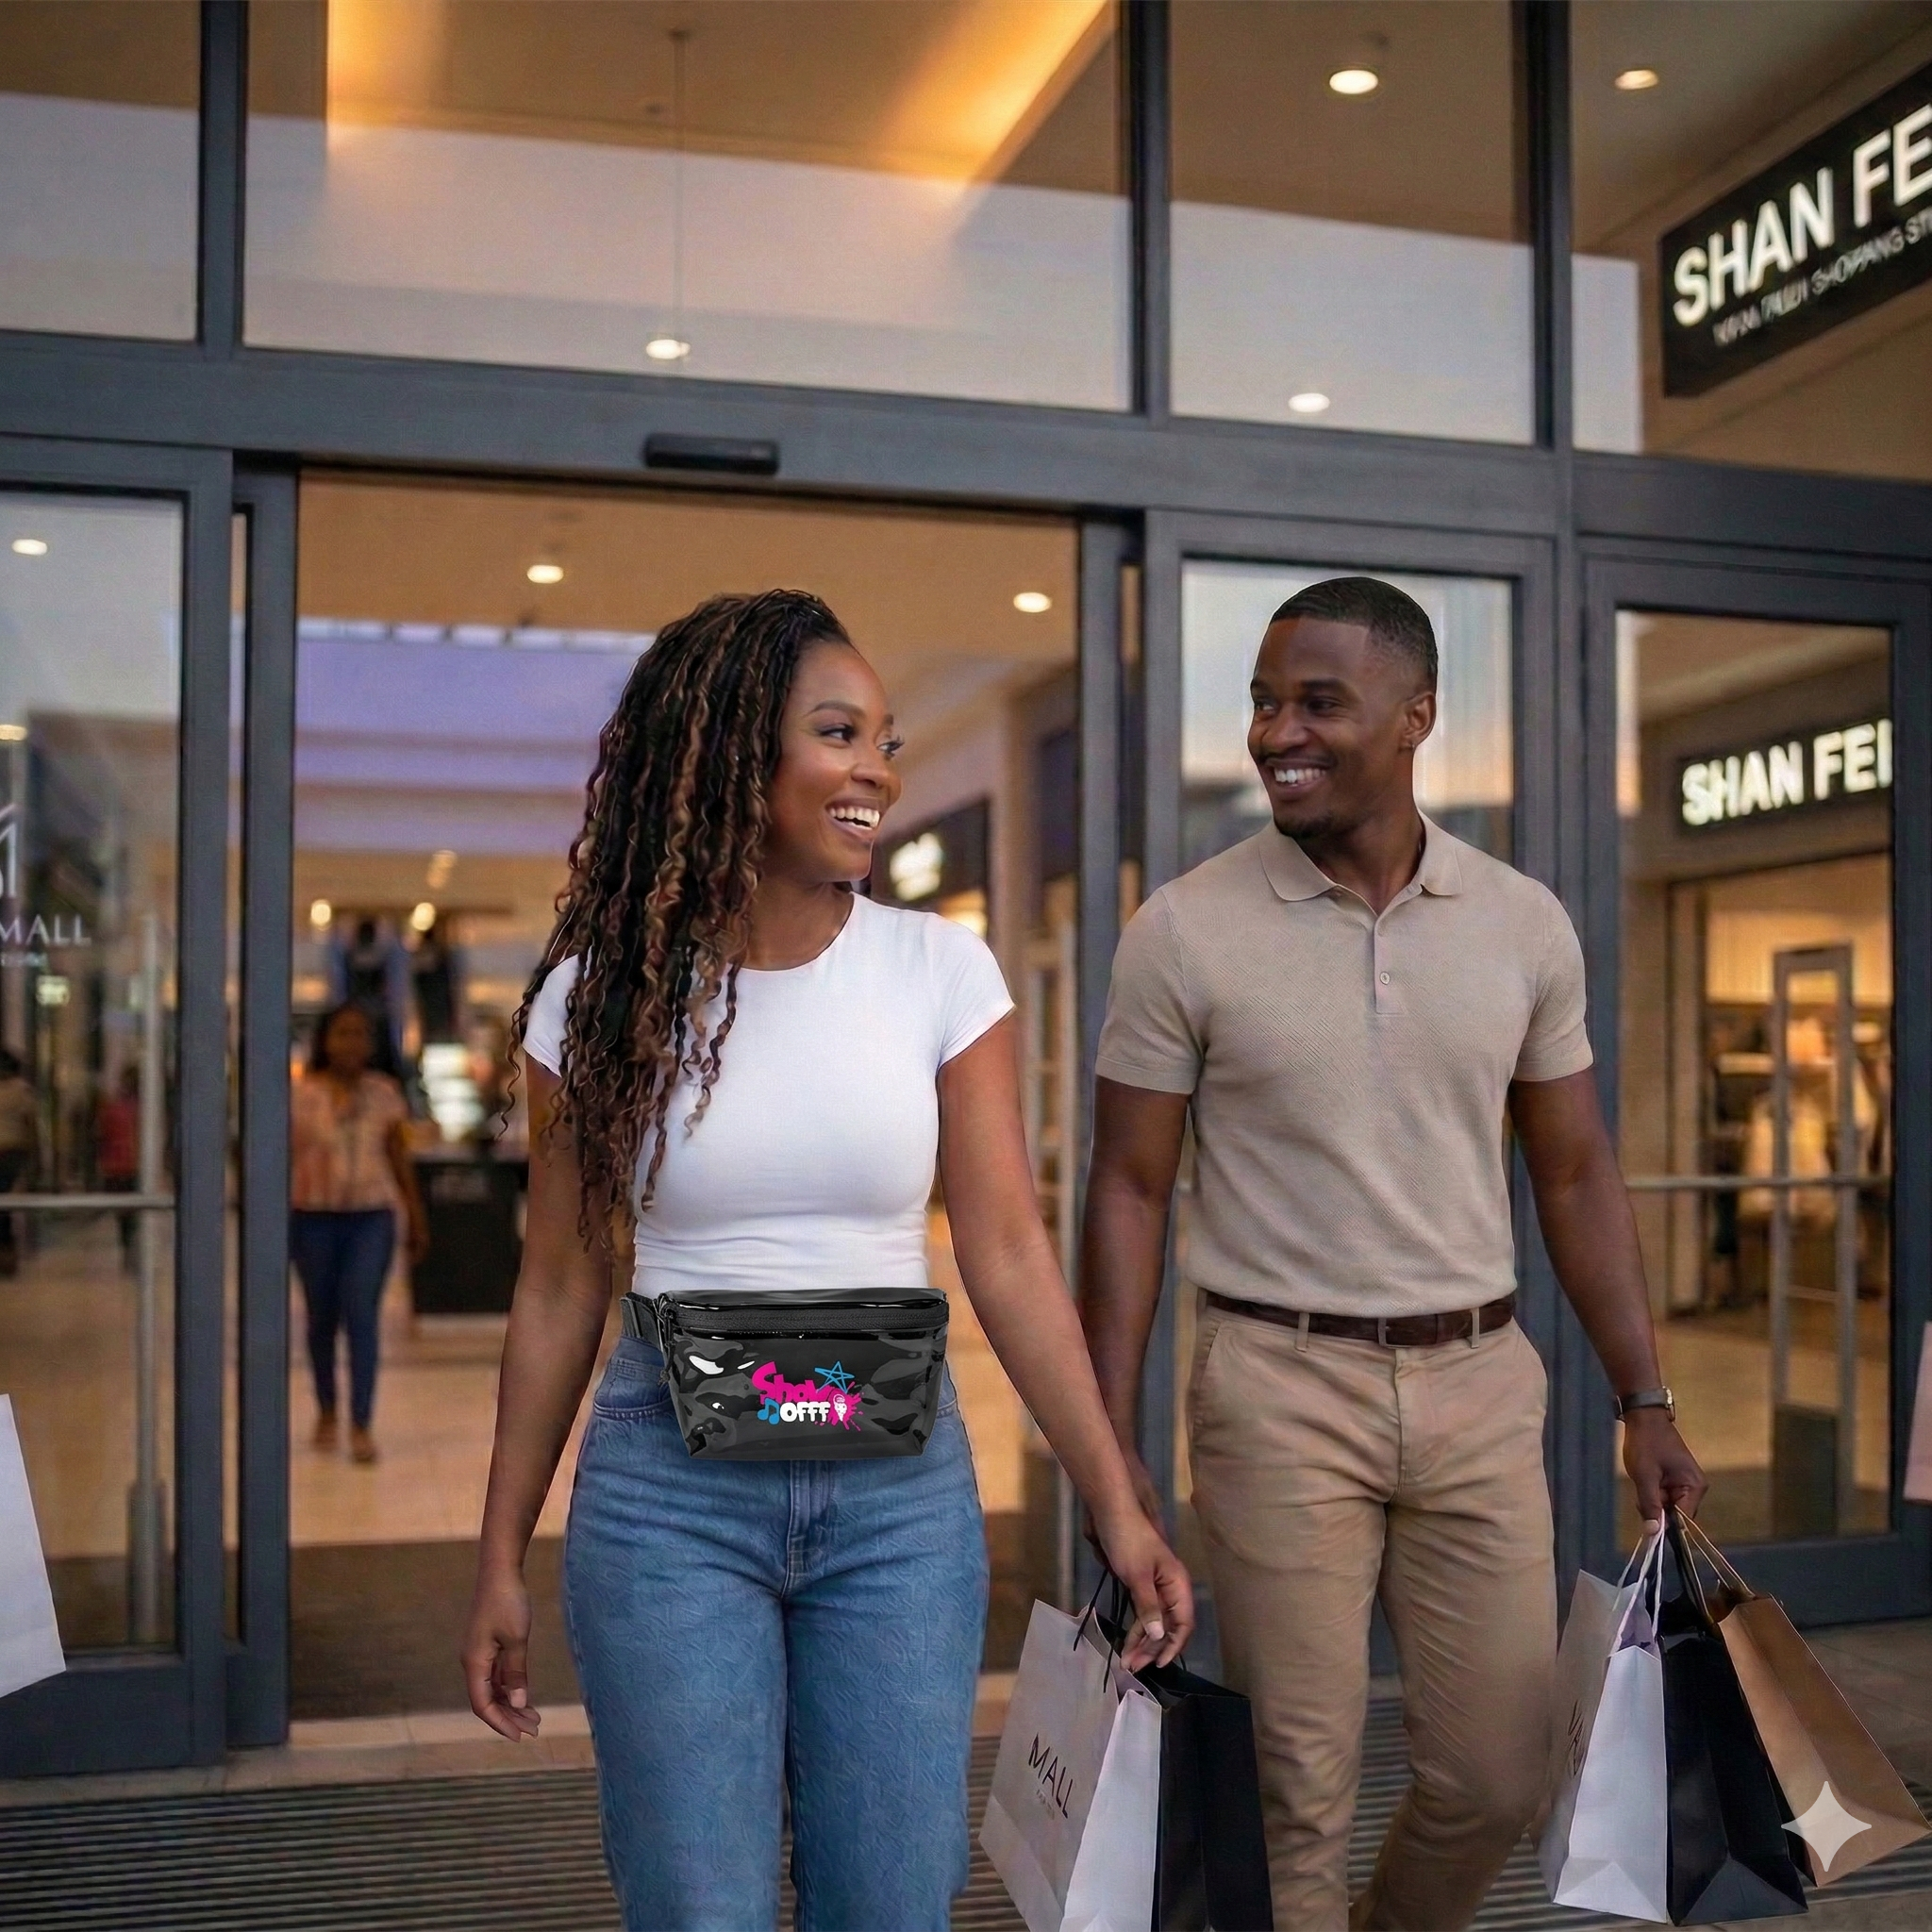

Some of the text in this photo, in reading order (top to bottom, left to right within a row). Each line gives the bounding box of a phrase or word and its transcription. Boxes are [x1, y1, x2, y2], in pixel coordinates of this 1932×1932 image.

[1673, 166, 1835, 326] SHAN
[1682, 741, 1805, 826] SHAN
[1028, 1732, 1074, 1819] MALL
